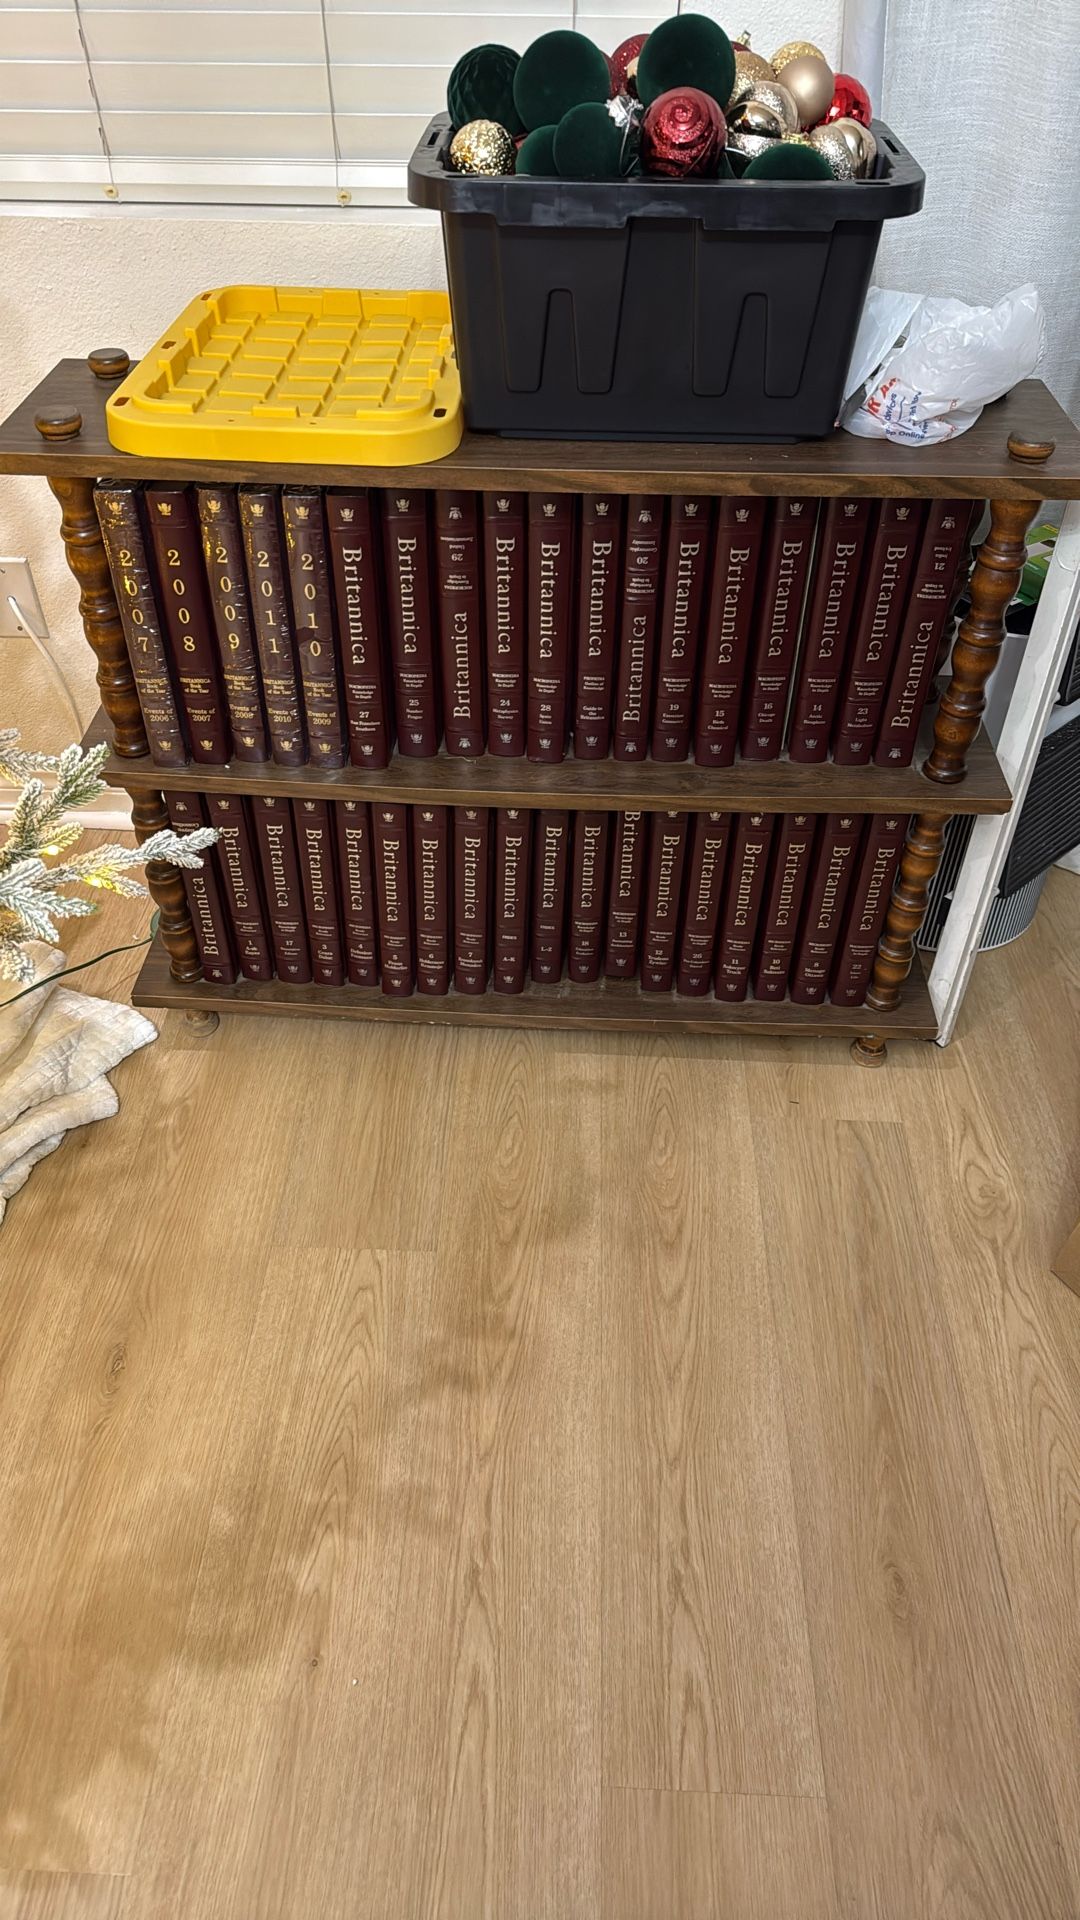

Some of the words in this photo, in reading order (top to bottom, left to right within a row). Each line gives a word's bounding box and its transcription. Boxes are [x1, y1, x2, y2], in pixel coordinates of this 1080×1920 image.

[215, 546, 240, 650] 2009
[397, 537, 420, 654] Britannica
[451, 553, 463, 561] 29
[495, 537, 515, 654] Britannica
[588, 540, 612, 657] Britannica
[636, 556, 649, 564] 20
[768, 540, 803, 658] Britannica
[935, 562, 945, 571] 21
[119, 550, 149, 652] 2007
[167, 549, 196, 652] 2008
[257, 551, 280, 654] 2011
[301, 553, 321, 657] 2010
[342, 547, 368, 665] Britannica
[539, 541, 561, 659] Britannica
[671, 541, 700, 658] Britannica
[718, 547, 750, 664] Britannica
[819, 542, 857, 659] Britannica
[866, 545, 908, 662] Britannica
[451, 612, 471, 719] Britannica
[622, 616, 647, 722] Britannica
[891, 621, 934, 728] Britannica
[144, 707, 165, 715] Events
[187, 707, 207, 715] Events
[268, 707, 289, 715] Events
[307, 710, 328, 718] Events
[359, 711, 370, 719] 27
[540, 704, 552, 712] 28
[813, 704, 822, 712] 14
[857, 707, 869, 715] 23
[222, 827, 249, 908] Britannica
[266, 824, 291, 908] Britannica
[306, 828, 328, 912] Britannica
[345, 828, 365, 911] Britannica
[382, 839, 401, 922] Britannica
[422, 839, 439, 921] Britannica
[464, 836, 481, 919] Britannica
[503, 836, 522, 919] Britannica
[542, 825, 563, 909] Britannica
[580, 825, 601, 908] Britannica
[619, 811, 641, 898] Britannica
[655, 834, 680, 917] Britannica
[695, 838, 722, 921] Britannica
[734, 843, 763, 927] Britannica
[775, 842, 806, 927] Britannica
[817, 845, 851, 930] Britannica
[859, 847, 896, 931] Britannica
[192, 877, 219, 956] Britannica
